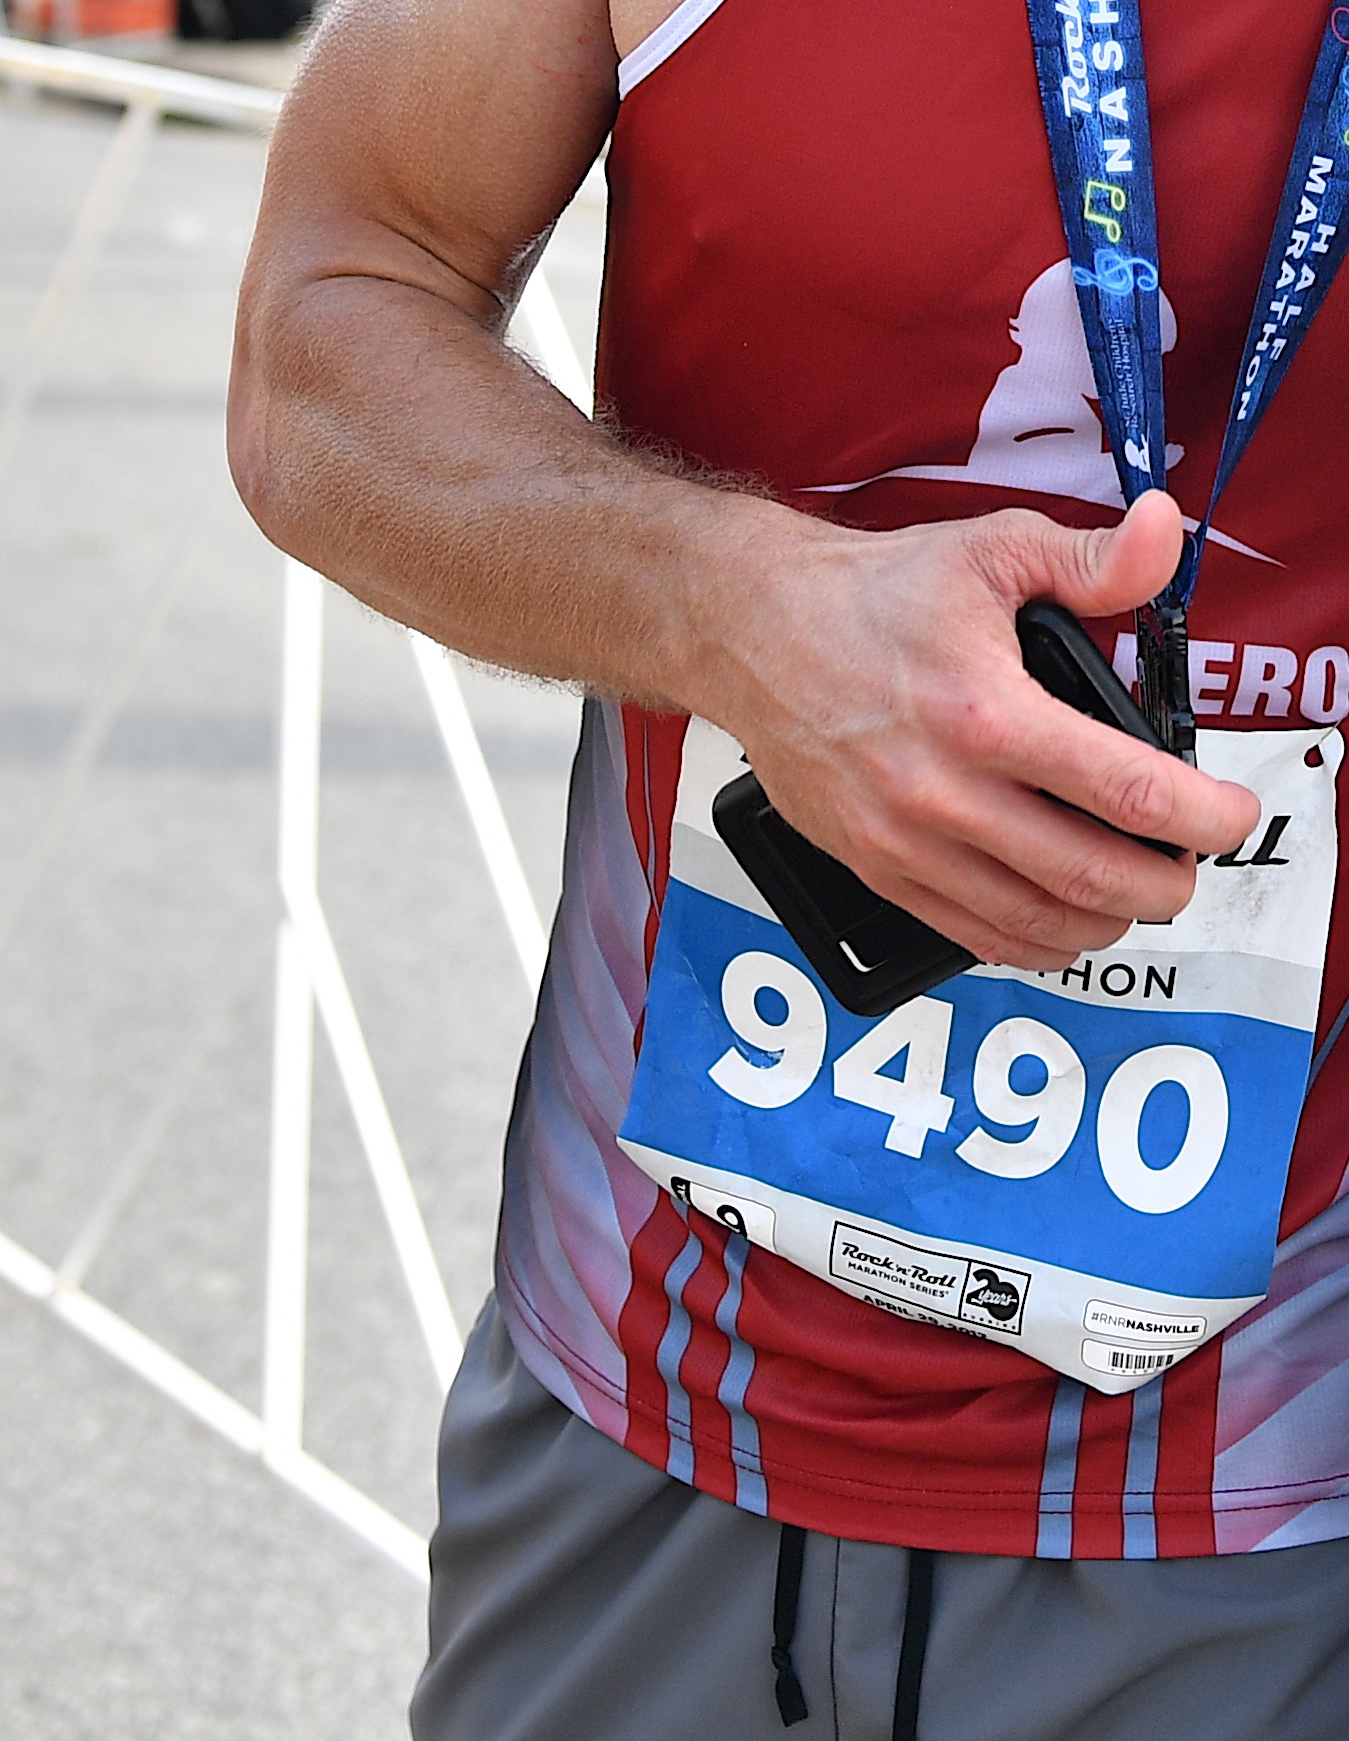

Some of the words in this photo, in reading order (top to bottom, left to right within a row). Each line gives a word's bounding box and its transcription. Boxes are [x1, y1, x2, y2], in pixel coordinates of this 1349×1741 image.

[1236, 155, 1333, 421] MARATHON
[1269, 224, 1337, 360] HALF
[707, 950, 1229, 1215] 9490
[847, 1261, 907, 1287] MARATHON
[864, 1294, 914, 1318] APRIL
[1091, 1311, 1200, 1334] #RNRNASHVILLE
